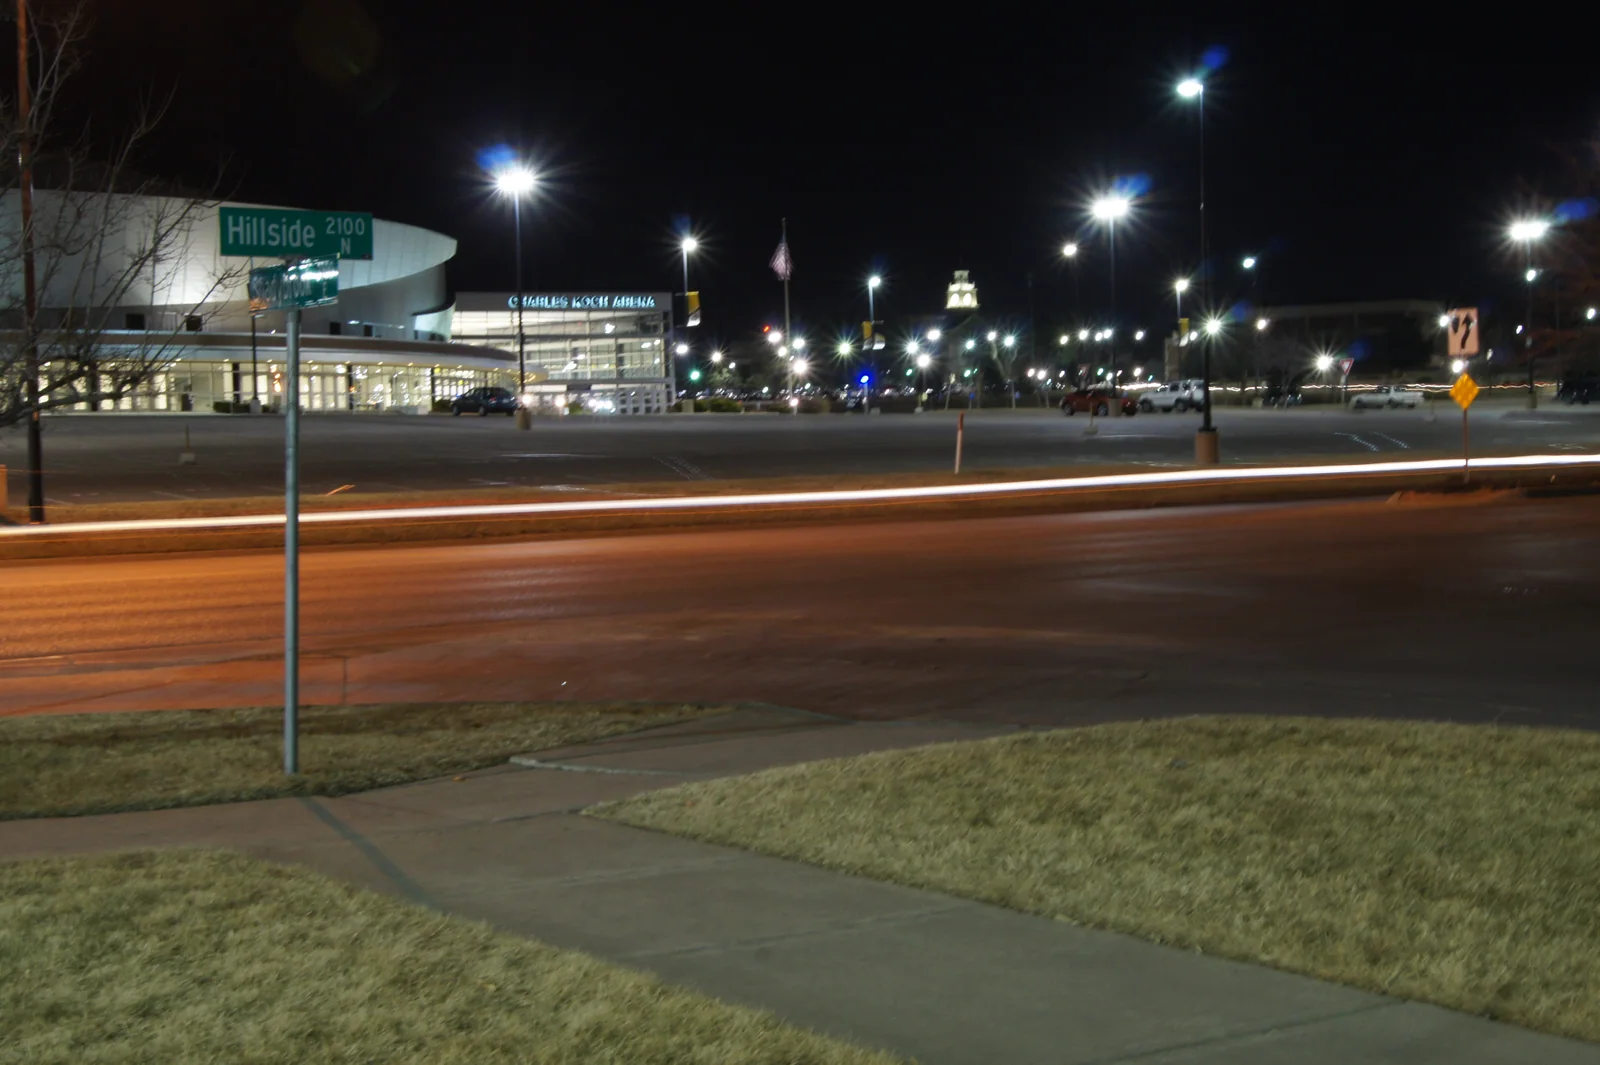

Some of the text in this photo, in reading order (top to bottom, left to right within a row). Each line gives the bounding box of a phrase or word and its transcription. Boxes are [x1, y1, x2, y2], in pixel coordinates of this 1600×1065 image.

[228, 215, 365, 247] Hillside 2100
[341, 238, 351, 254] N
[508, 295, 656, 309] CHARLES KOCH ARENA
